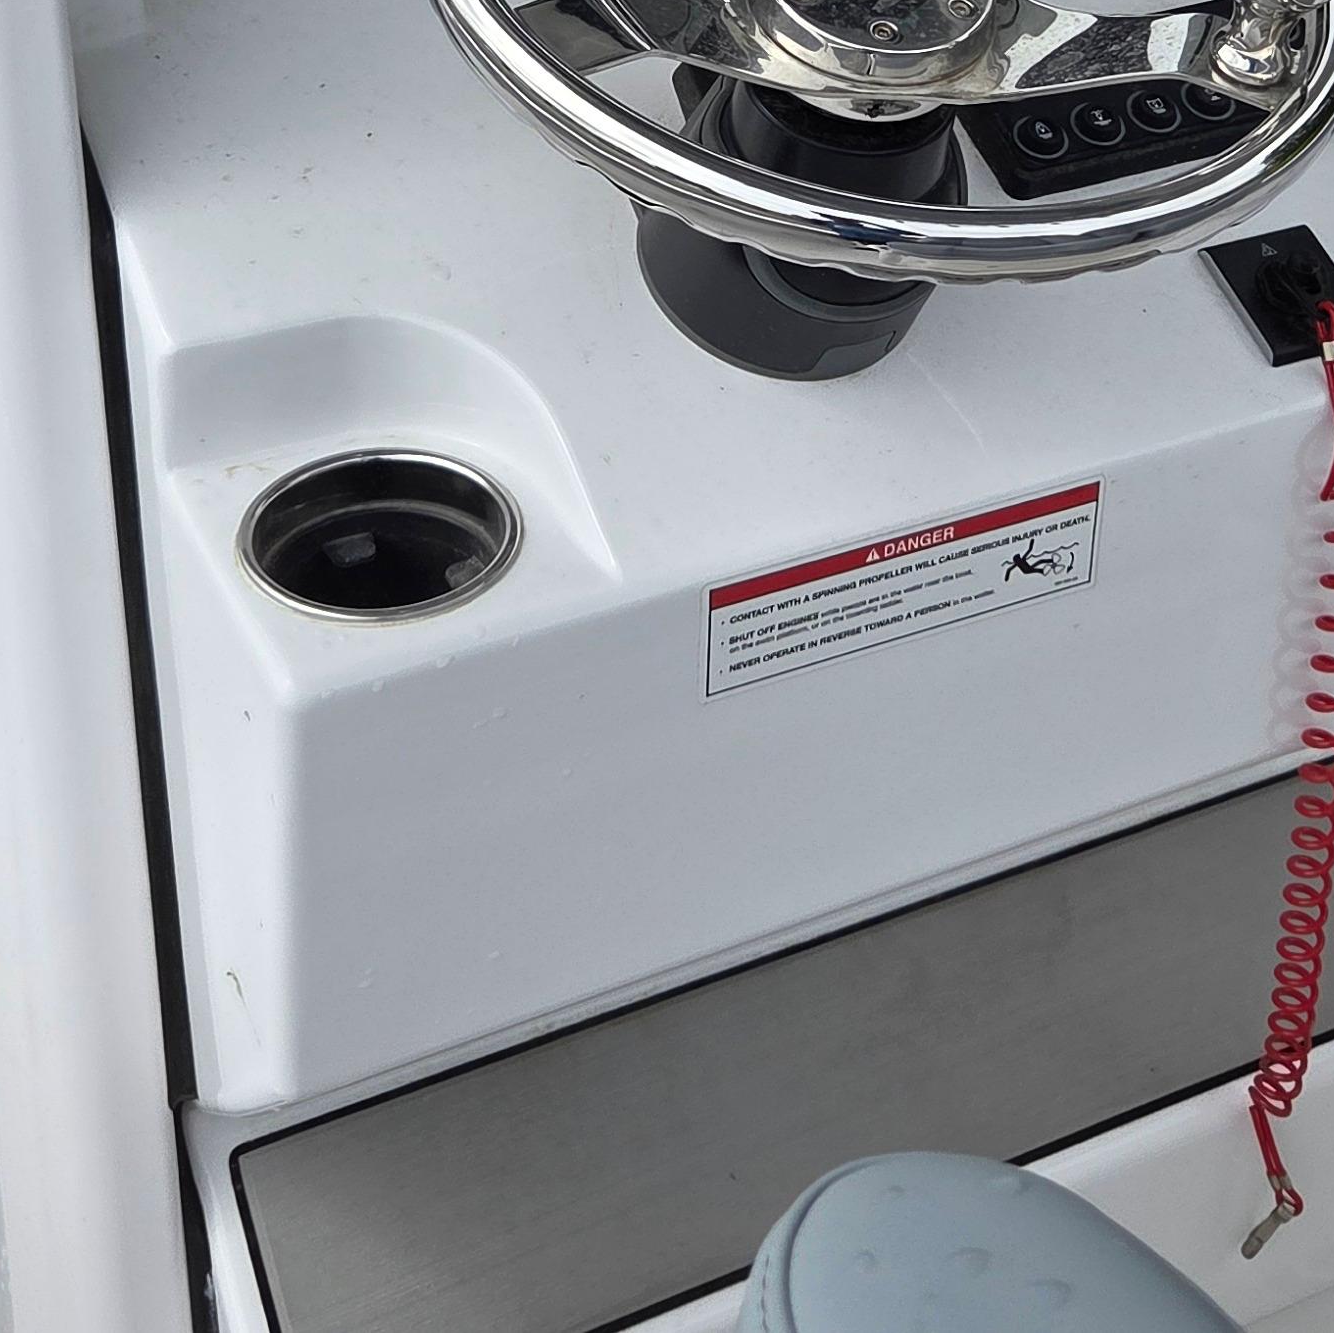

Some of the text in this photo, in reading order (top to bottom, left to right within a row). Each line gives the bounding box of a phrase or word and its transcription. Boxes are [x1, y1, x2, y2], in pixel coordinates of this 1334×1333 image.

[884, 526, 955, 557] DANGER
[729, 605, 775, 624] CONTACT
[777, 597, 801, 611] WITH
[812, 580, 857, 600] SPINNING
[859, 565, 913, 587] PROPELLER
[915, 559, 937, 571] WILL
[938, 548, 969, 564] CAUSE
[971, 537, 1010, 554] SERIOUS
[1012, 528, 1044, 543] INJURY
[1045, 524, 1058, 533] OR
[729, 630, 756, 645] SHUT
[757, 624, 776, 637] OFF
[777, 612, 819, 630] ENGINES
[729, 657, 760, 672] NEVER
[763, 643, 806, 662] OPERATE
[808, 640, 818, 648] IN
[820, 626, 862, 645] REVERSE
[864, 614, 904, 632] TOWARD
[905, 612, 912, 620] A
[914, 600, 951, 617] PERSON
